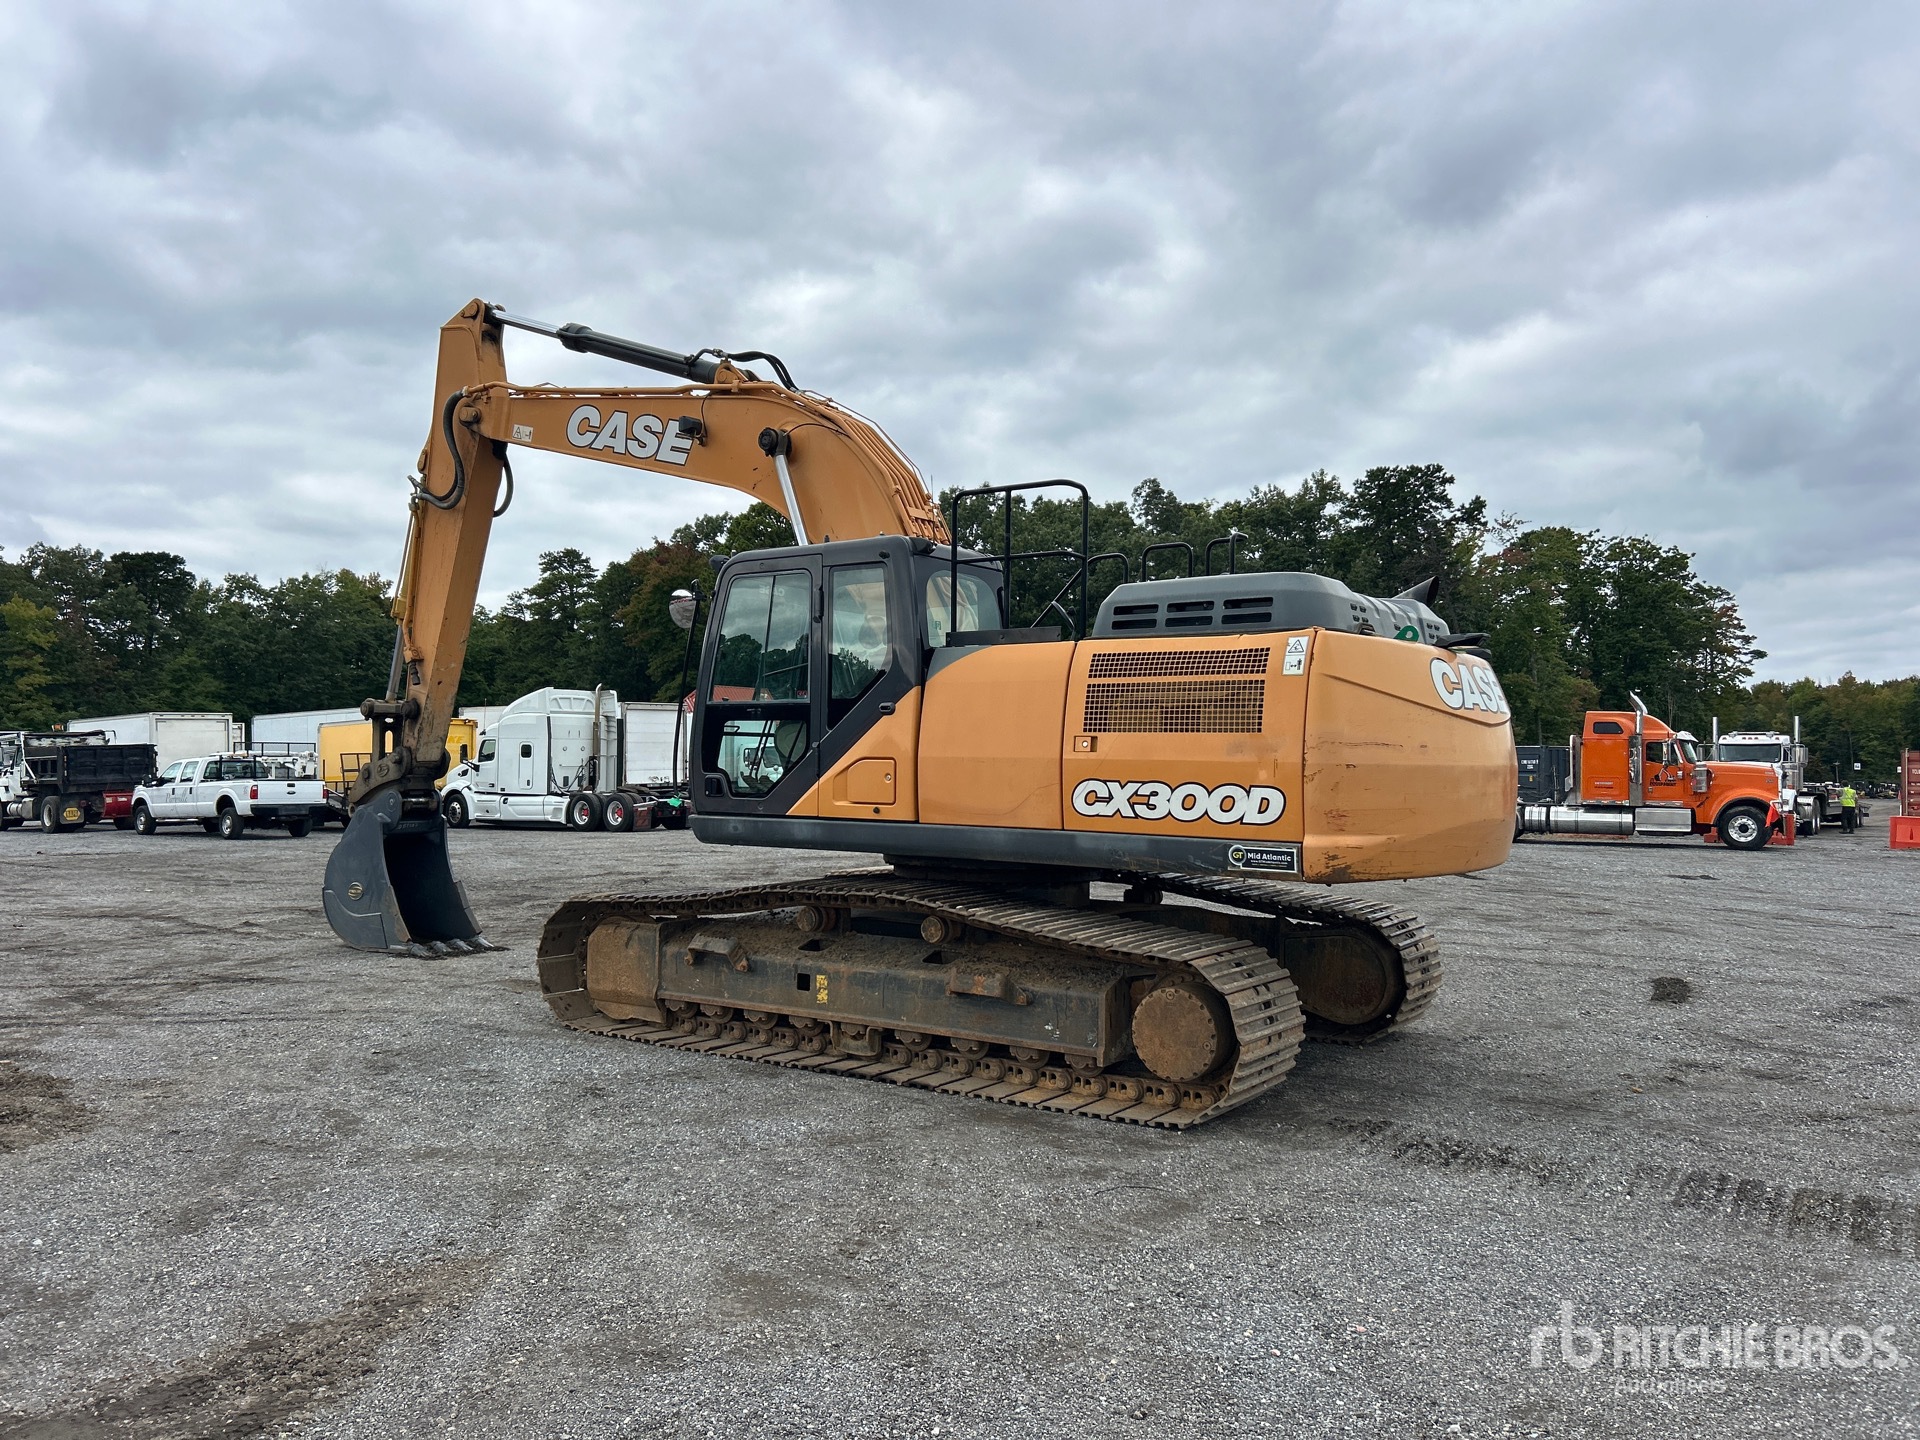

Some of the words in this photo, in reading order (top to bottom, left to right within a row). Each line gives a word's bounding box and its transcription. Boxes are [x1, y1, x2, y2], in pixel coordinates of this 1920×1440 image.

[566, 404, 693, 466] CASE
[1430, 657, 1508, 714] CASE
[1071, 778, 1286, 826] CX300D
[1232, 851, 1244, 859] GT
[1247, 852, 1261, 860] Mid
[1262, 853, 1292, 862] Atlantic
